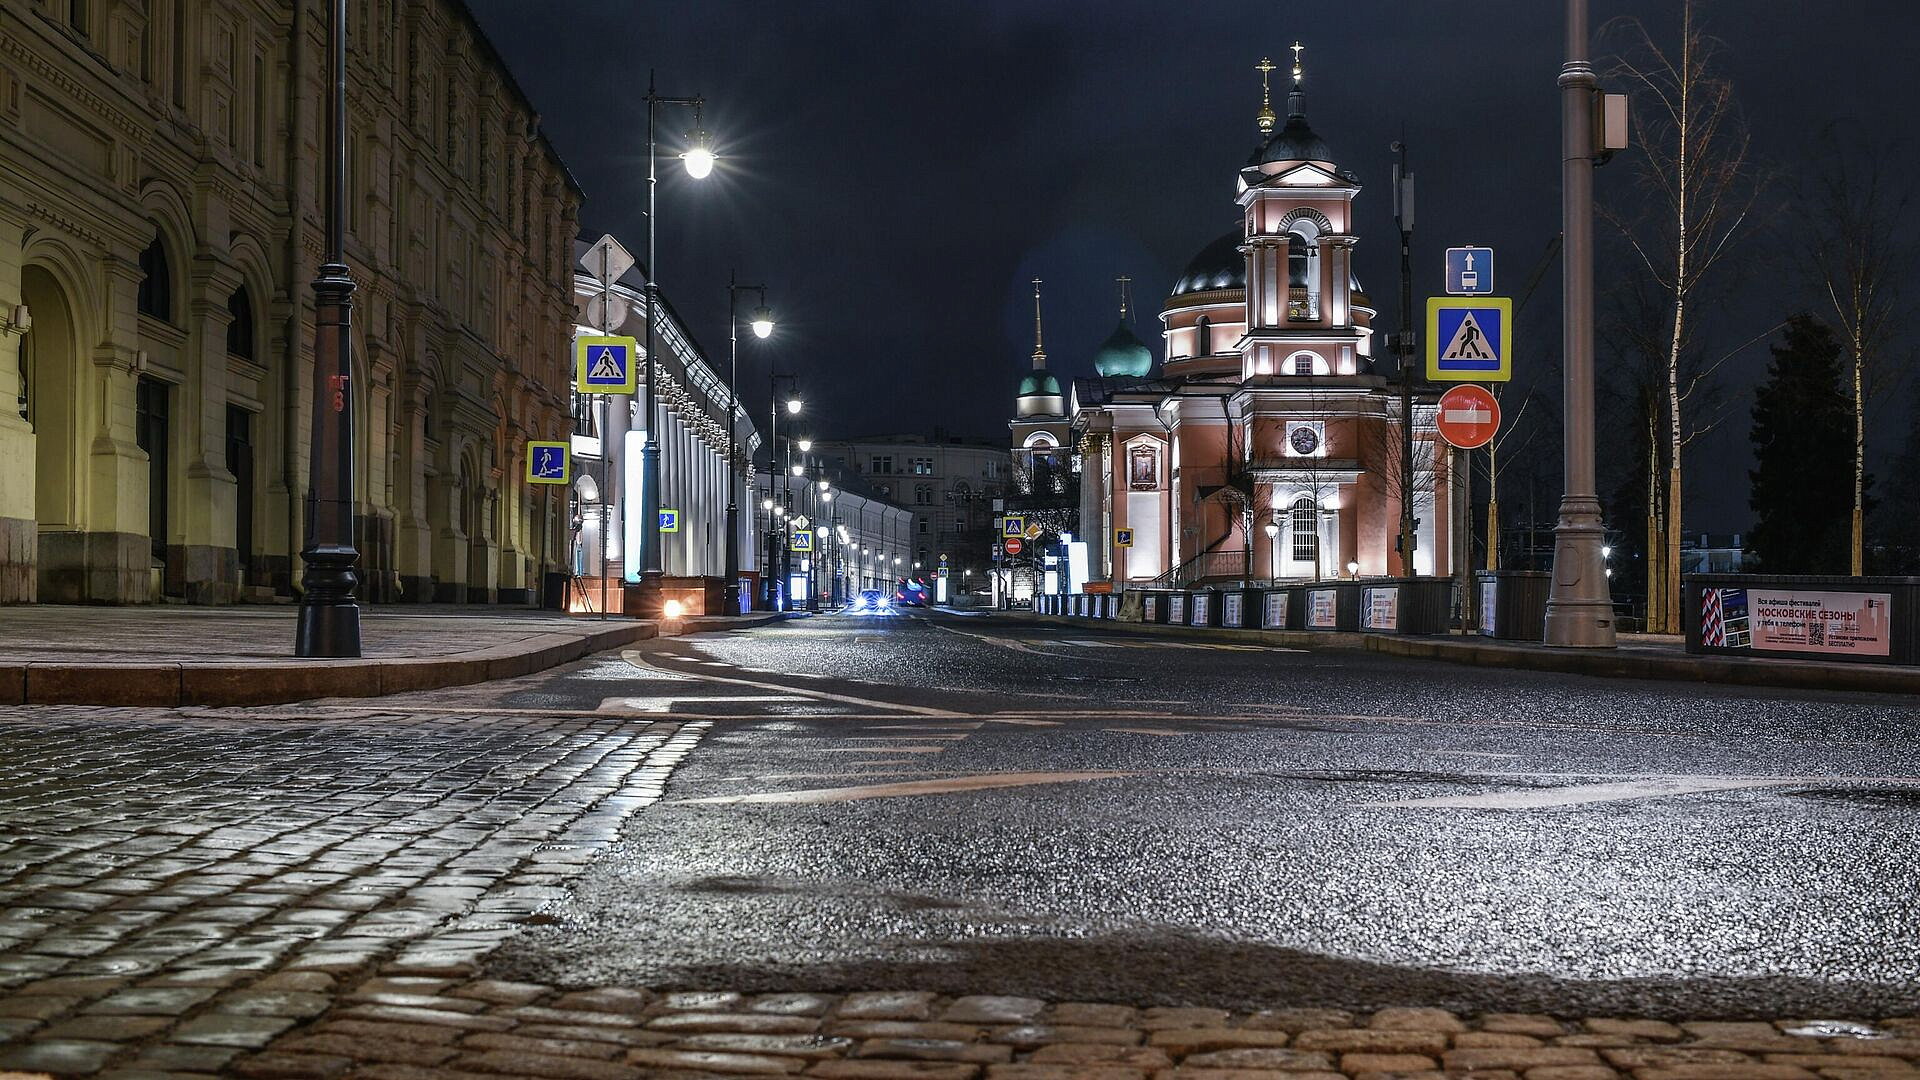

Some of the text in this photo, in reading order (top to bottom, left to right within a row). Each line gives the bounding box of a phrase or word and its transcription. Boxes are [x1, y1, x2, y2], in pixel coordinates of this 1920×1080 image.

[334, 391, 344, 411] 8
[1758, 598, 1820, 607] Вся афиша фестивалей
[1758, 608, 1856, 621] МОСКОВСКИЕ СЕЗОНЫ
